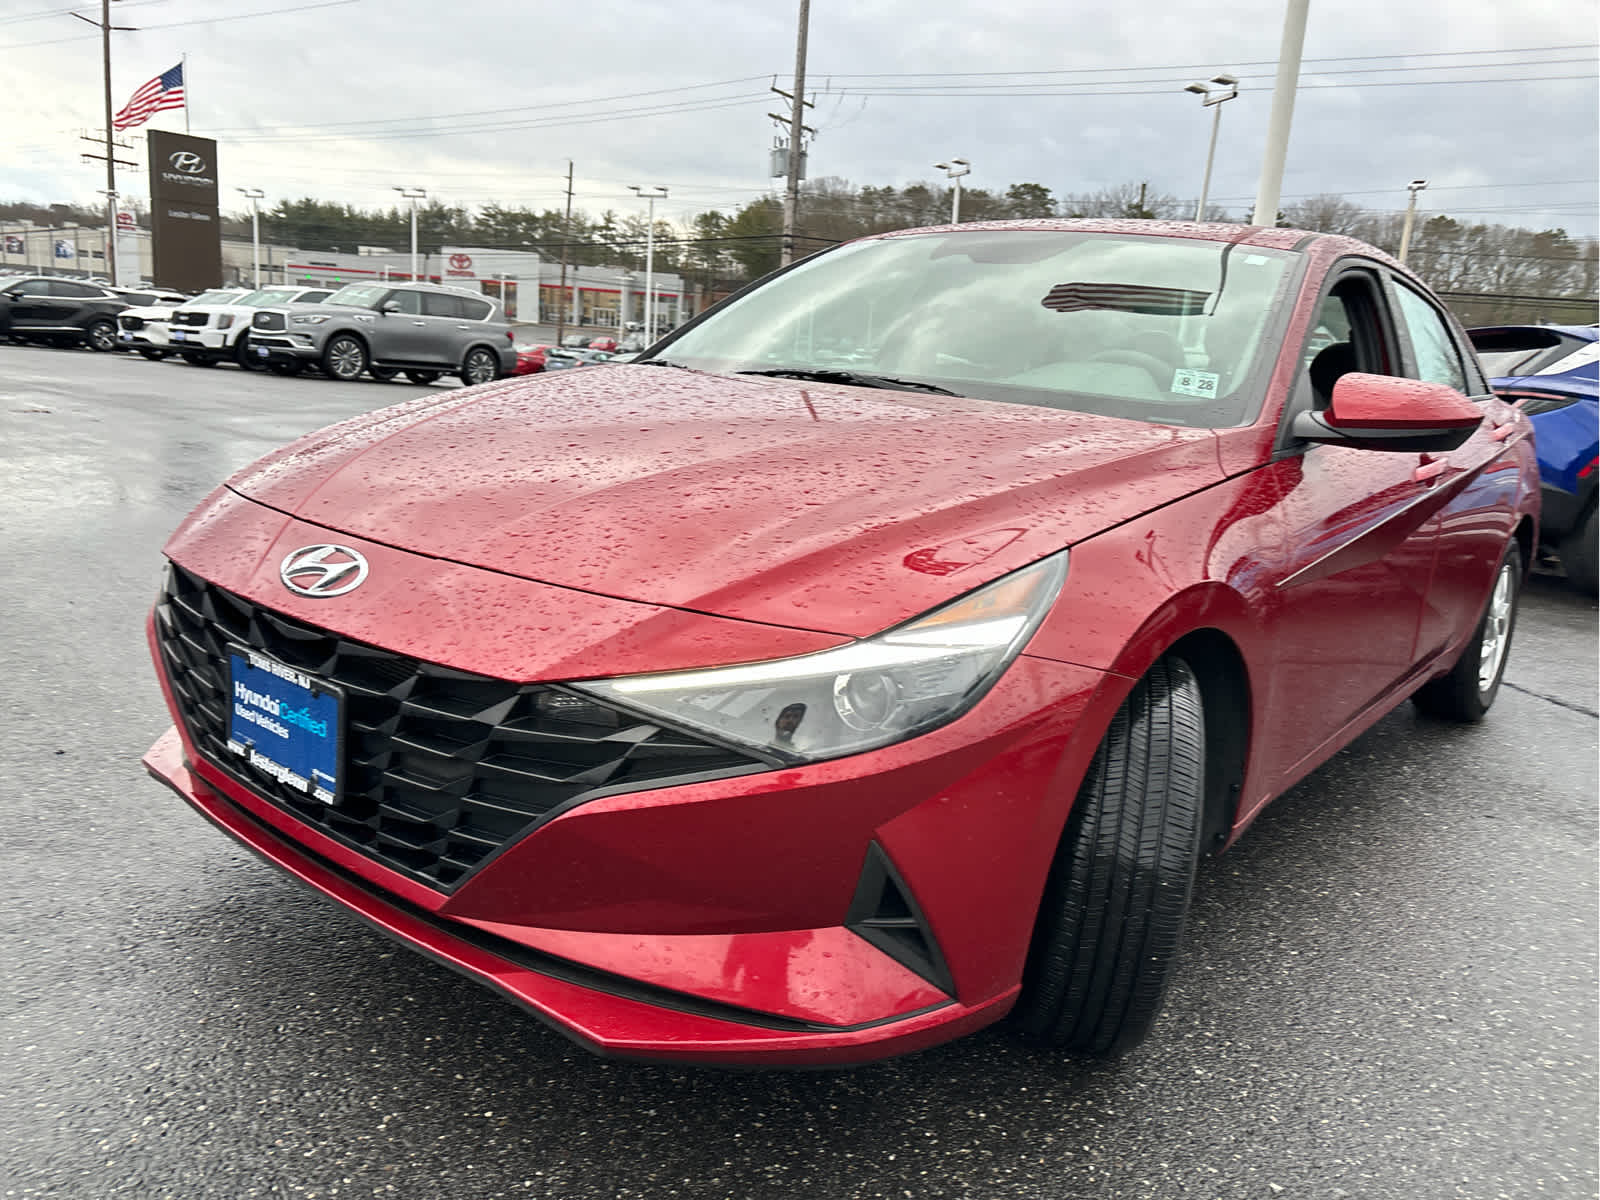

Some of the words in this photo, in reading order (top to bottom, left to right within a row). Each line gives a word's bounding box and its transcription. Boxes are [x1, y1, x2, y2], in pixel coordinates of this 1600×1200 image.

[1182, 377, 1191, 386] 8
[1198, 379, 1214, 390] 28
[234, 703, 256, 723] Used
[255, 711, 289, 739] Vehicles
